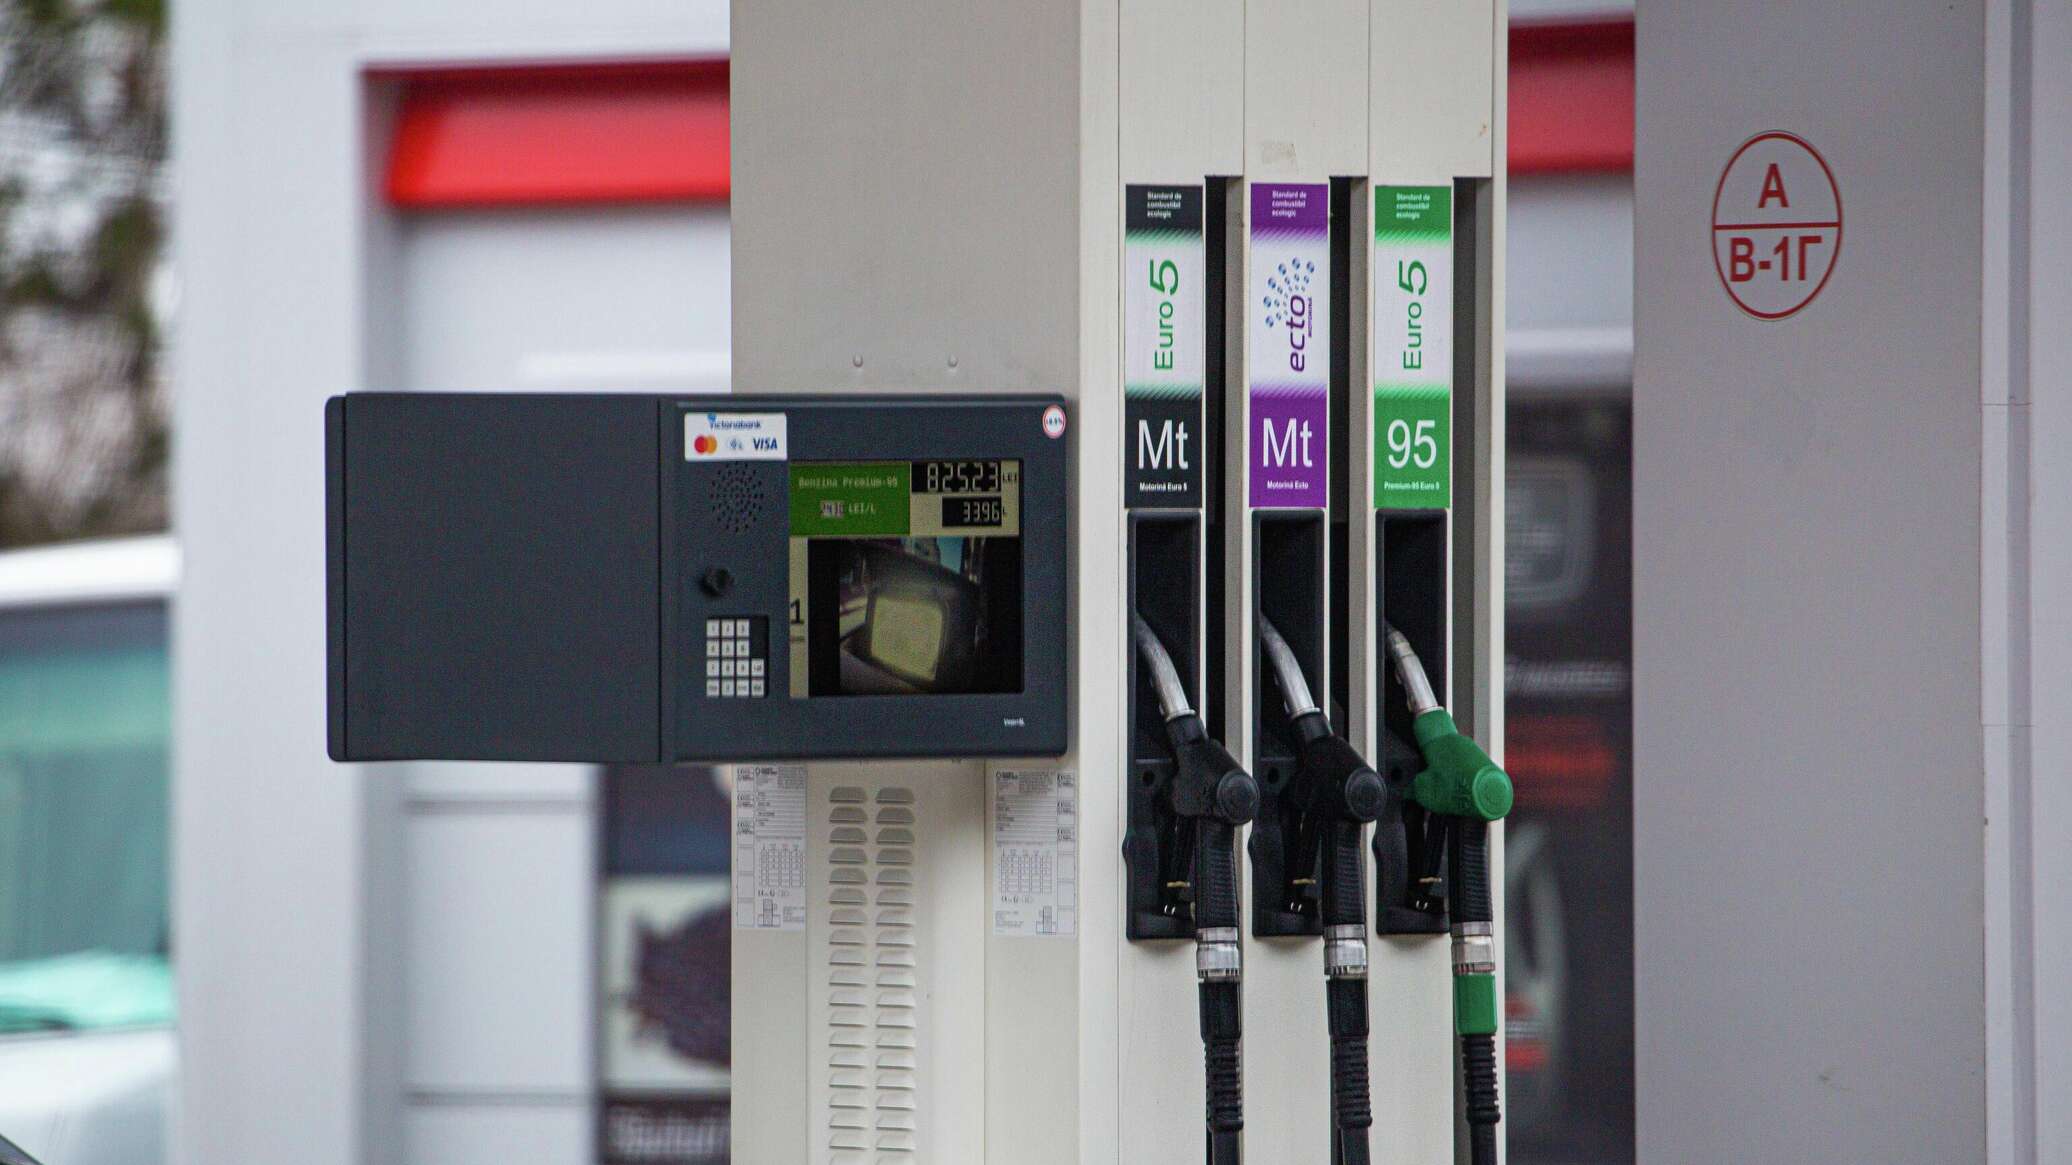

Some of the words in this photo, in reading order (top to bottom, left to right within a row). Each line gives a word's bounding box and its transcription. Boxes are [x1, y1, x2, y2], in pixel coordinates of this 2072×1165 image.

[1150, 259, 1179, 296] 5
[1398, 260, 1427, 296] 5
[1155, 301, 1173, 370] Euro
[1286, 295, 1305, 372] ecto
[1403, 302, 1421, 370] Euro
[752, 437, 778, 451] VISA
[1138, 419, 1189, 470] Mt
[1263, 417, 1313, 468] Mt
[1387, 419, 1438, 469] 95
[1167, 482, 1182, 491] Euro
[790, 598, 805, 624] 1
